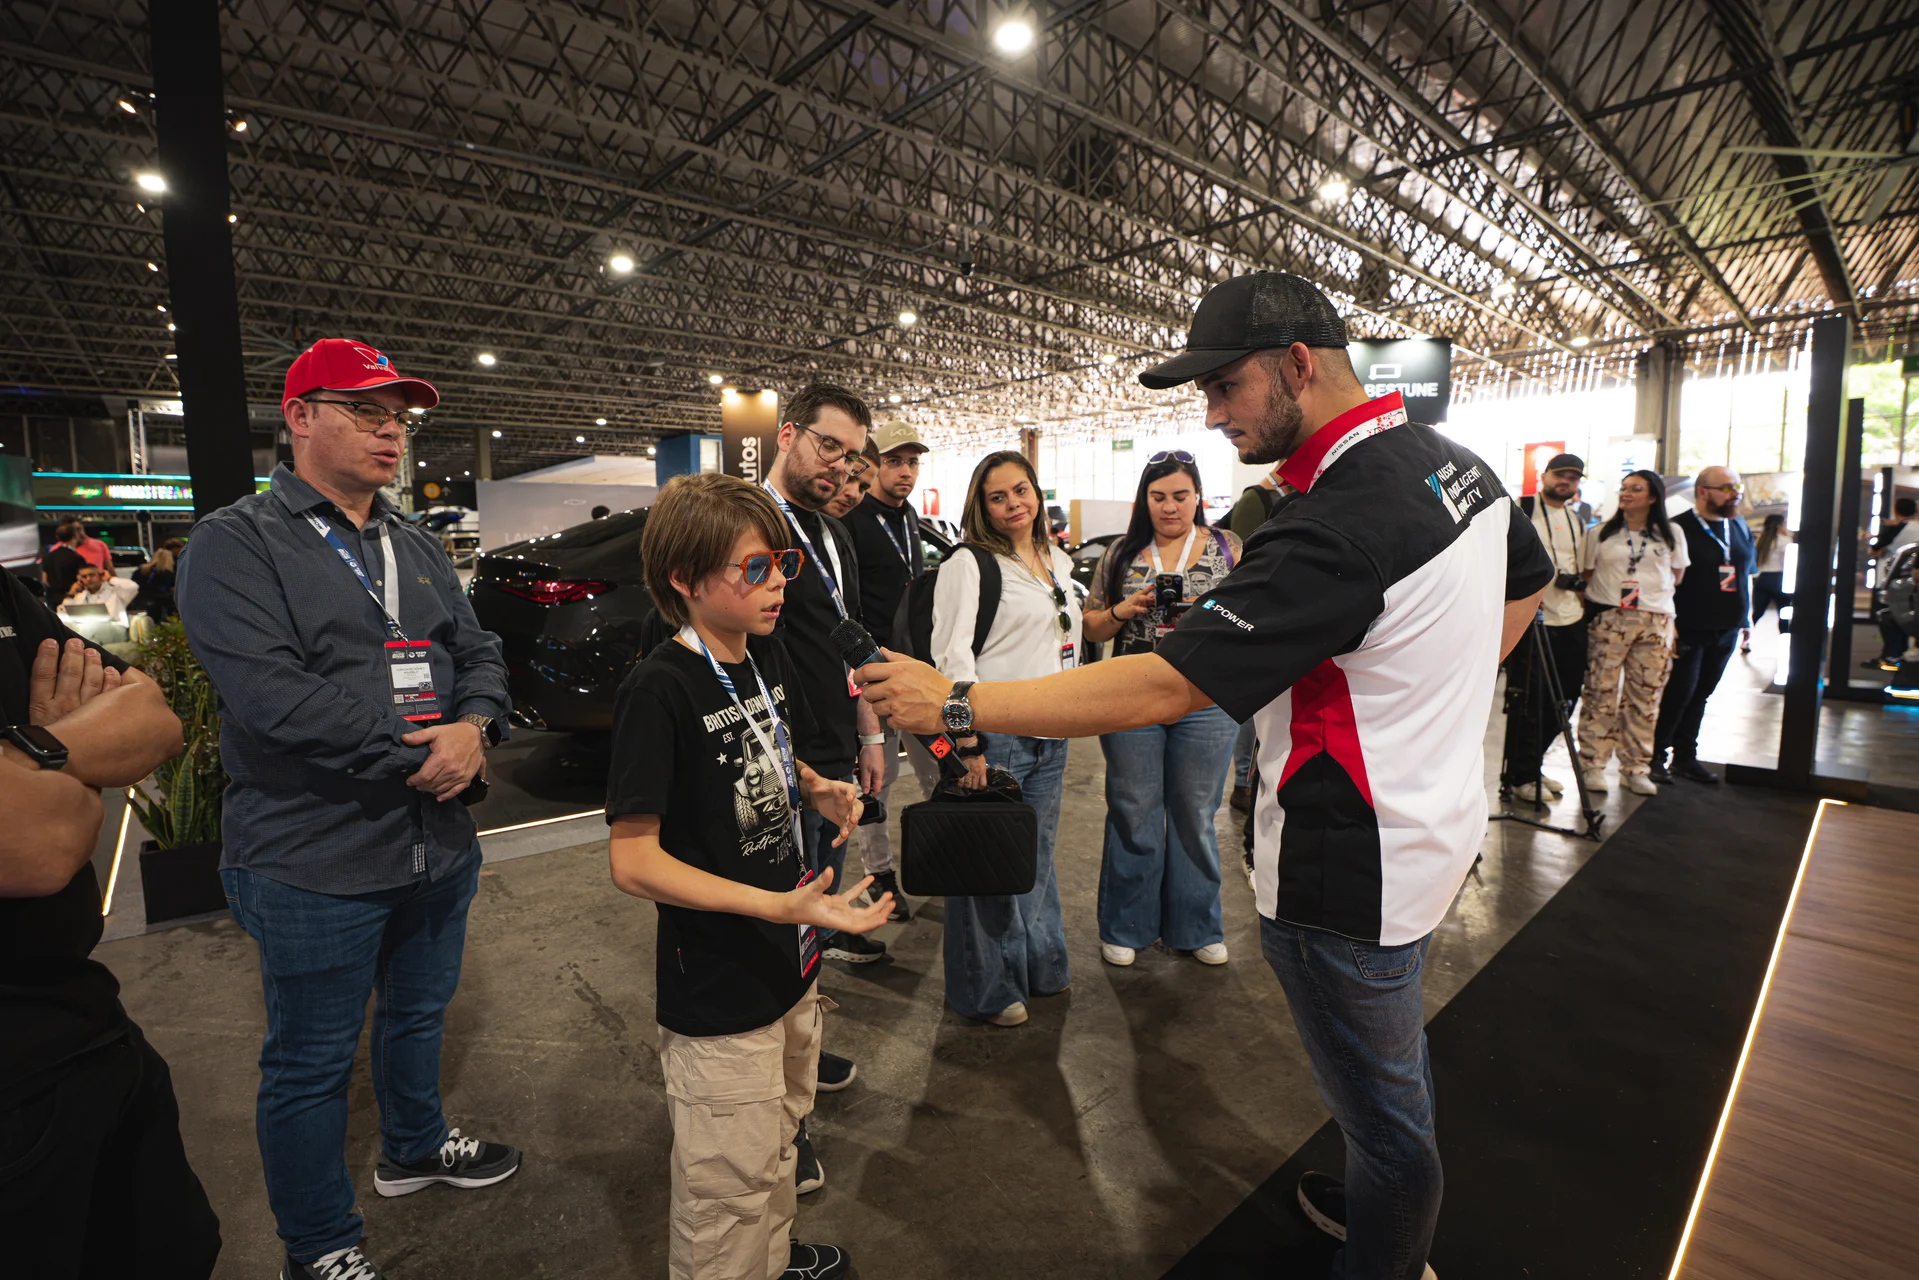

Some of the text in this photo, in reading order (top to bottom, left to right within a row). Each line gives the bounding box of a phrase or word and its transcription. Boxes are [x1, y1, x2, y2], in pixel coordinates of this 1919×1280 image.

[1363, 382, 1439, 398] BESTUNE
[1331, 431, 1360, 456] NISSAN
[738, 436, 758, 485] utos
[722, 731, 736, 744] EST.
